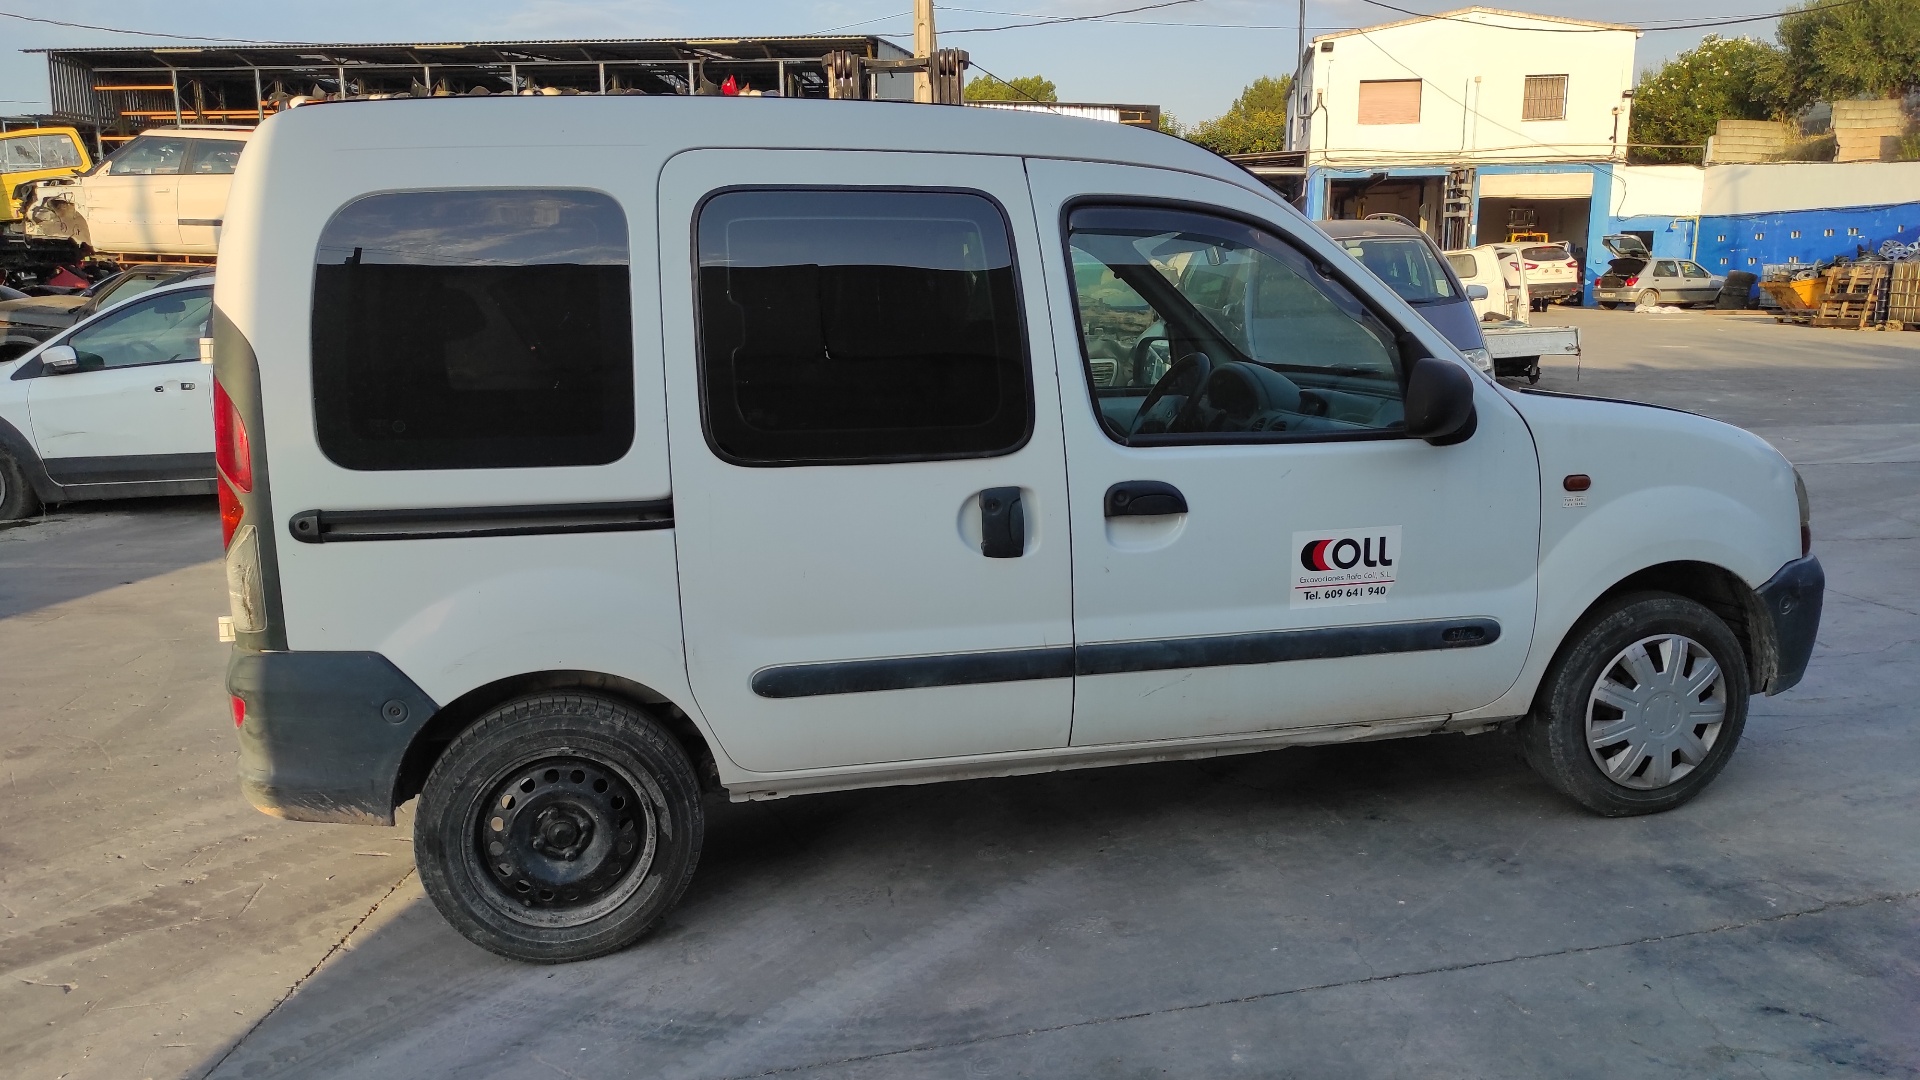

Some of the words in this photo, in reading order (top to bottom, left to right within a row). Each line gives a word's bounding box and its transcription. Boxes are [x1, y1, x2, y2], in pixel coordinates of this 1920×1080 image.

[1304, 590, 1321, 600] Tel.
[1324, 589, 1343, 599] 609
[1346, 587, 1363, 597] 641
[1368, 586, 1386, 595] 940
